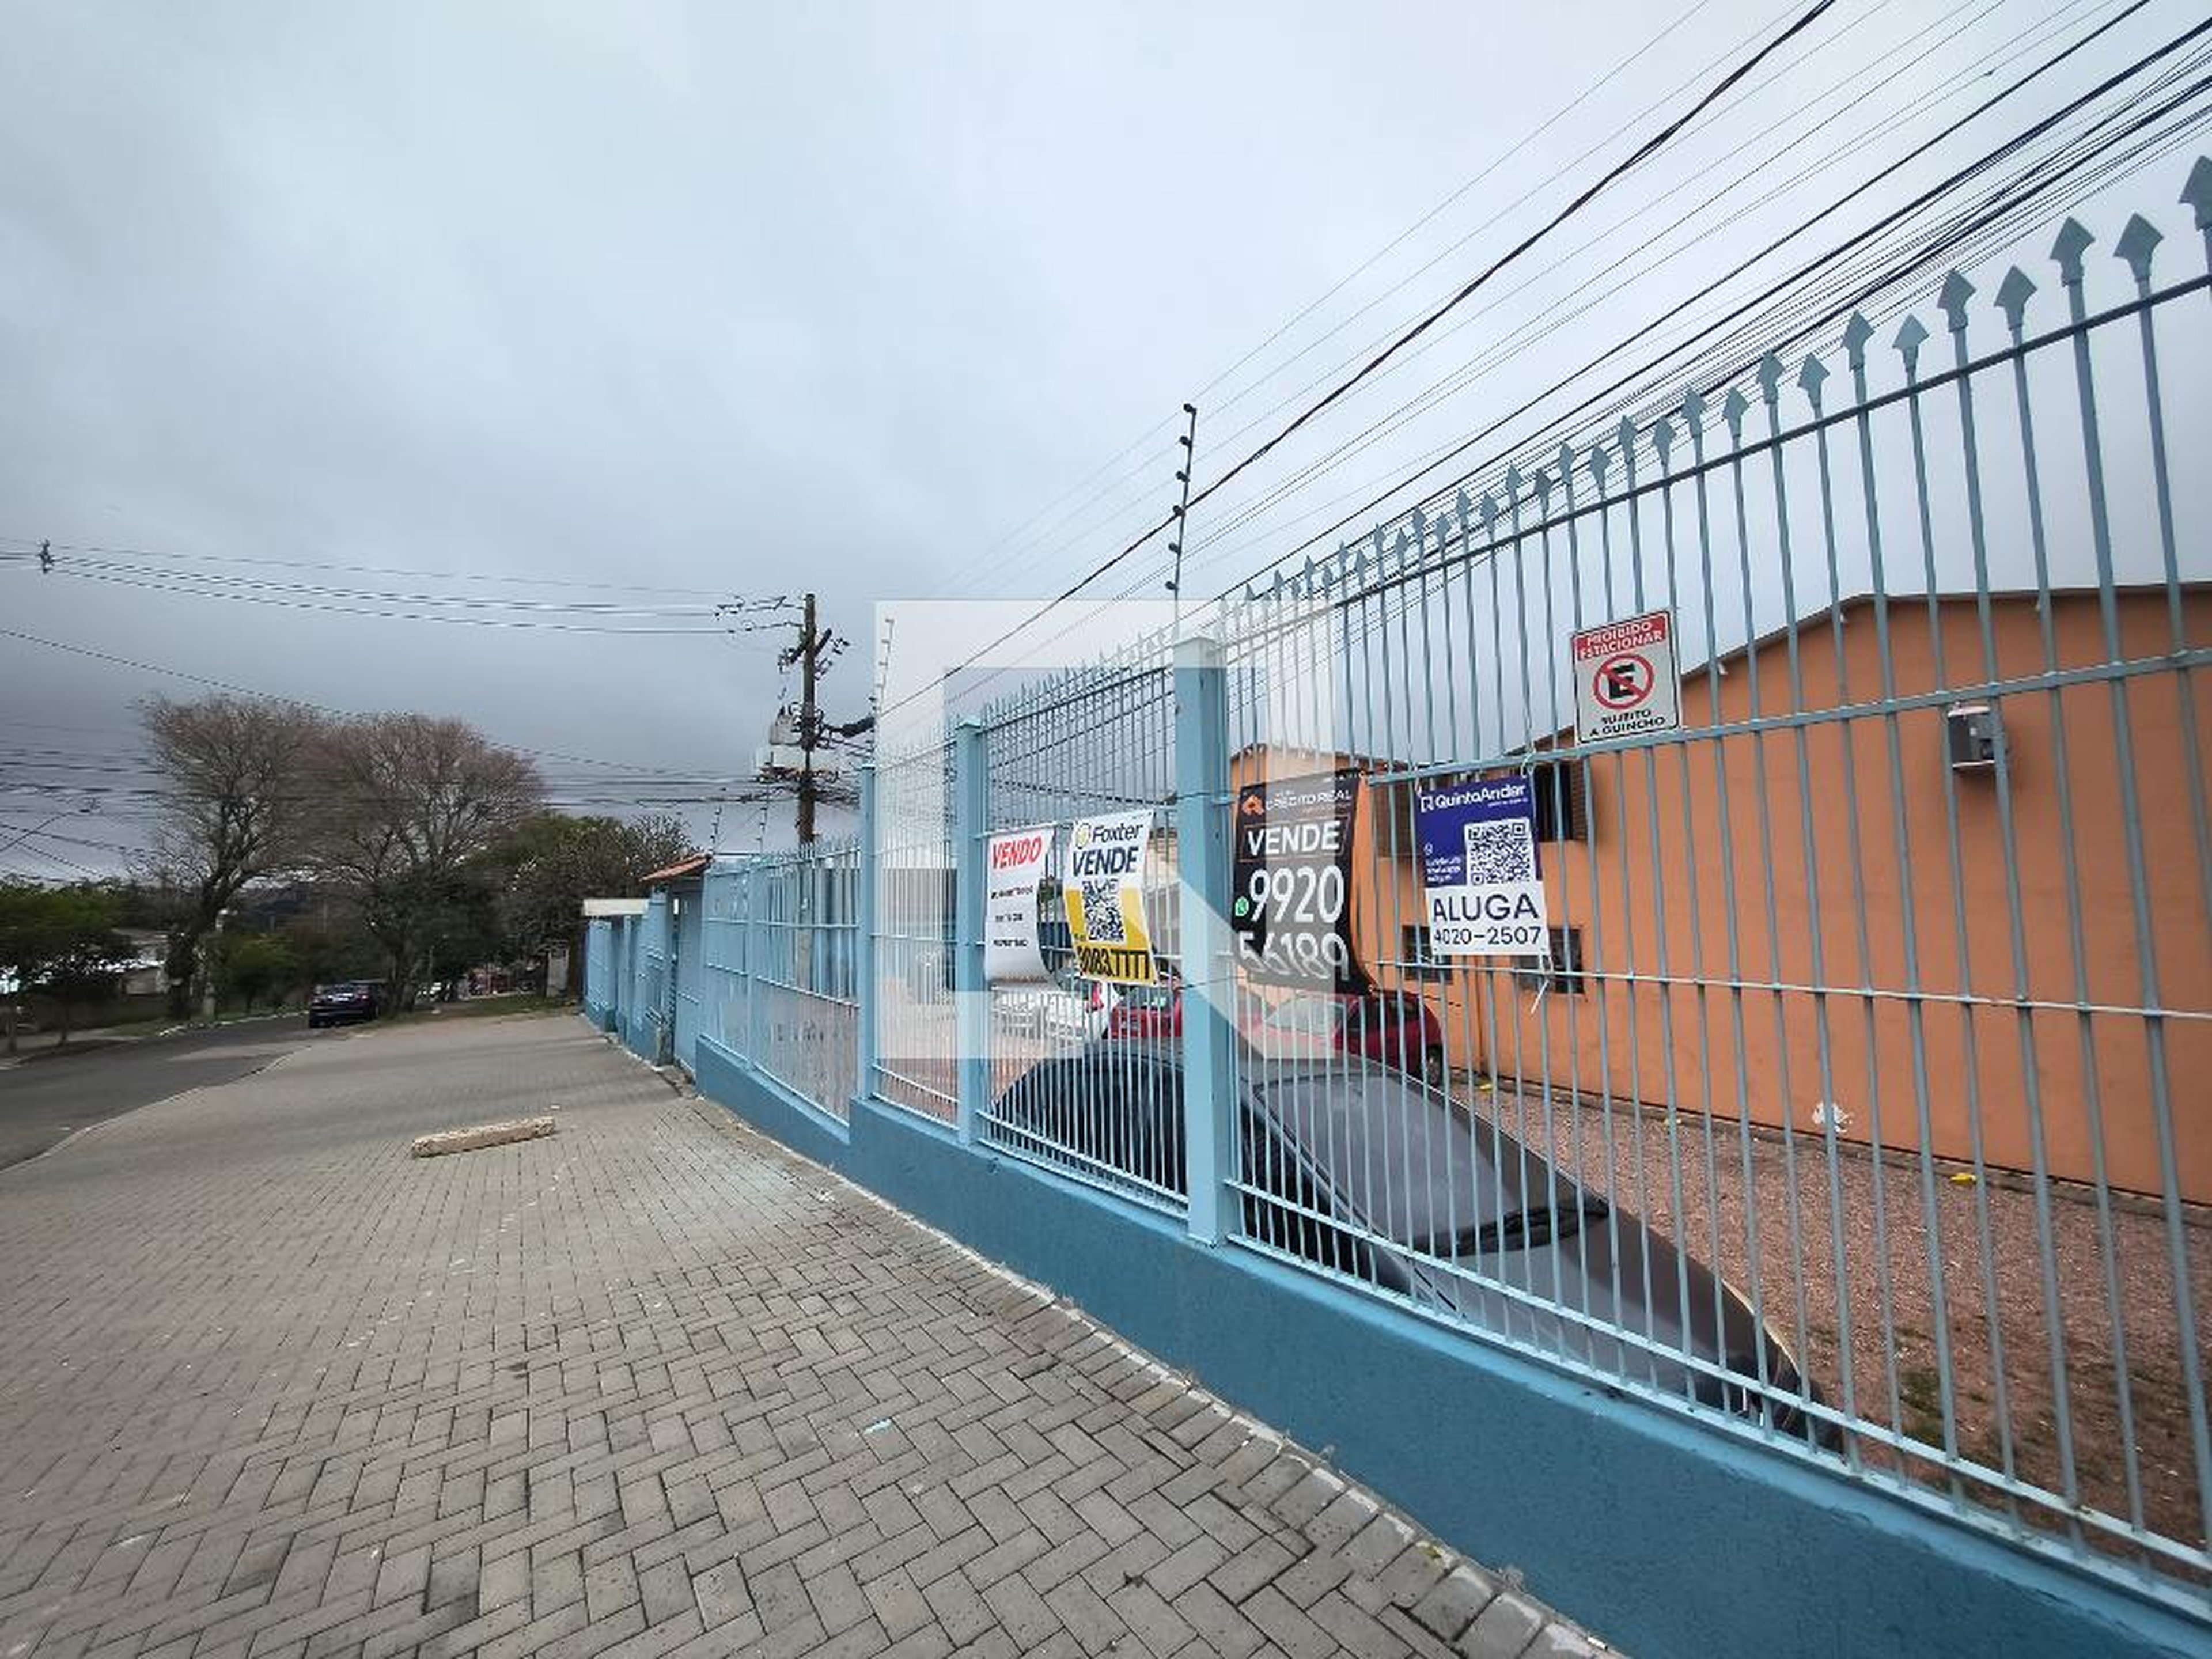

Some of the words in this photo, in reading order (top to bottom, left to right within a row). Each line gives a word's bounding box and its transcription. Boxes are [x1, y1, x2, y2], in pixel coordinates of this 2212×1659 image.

[1581, 630, 1662, 659] ESTACIONAR
[1589, 728, 1599, 737] A
[1602, 716, 1665, 735] GUINCHO
[1092, 822, 1143, 843] Foxter
[1248, 820, 1341, 856] VENDE
[993, 837, 1042, 869] VENDO
[1073, 846, 1139, 876] VENDE
[1249, 865, 1344, 923] 9920
[1433, 893, 1540, 922] ALUGA
[1434, 926, 1542, 946] 4020-2507
[1239, 931, 1349, 981] 56189
